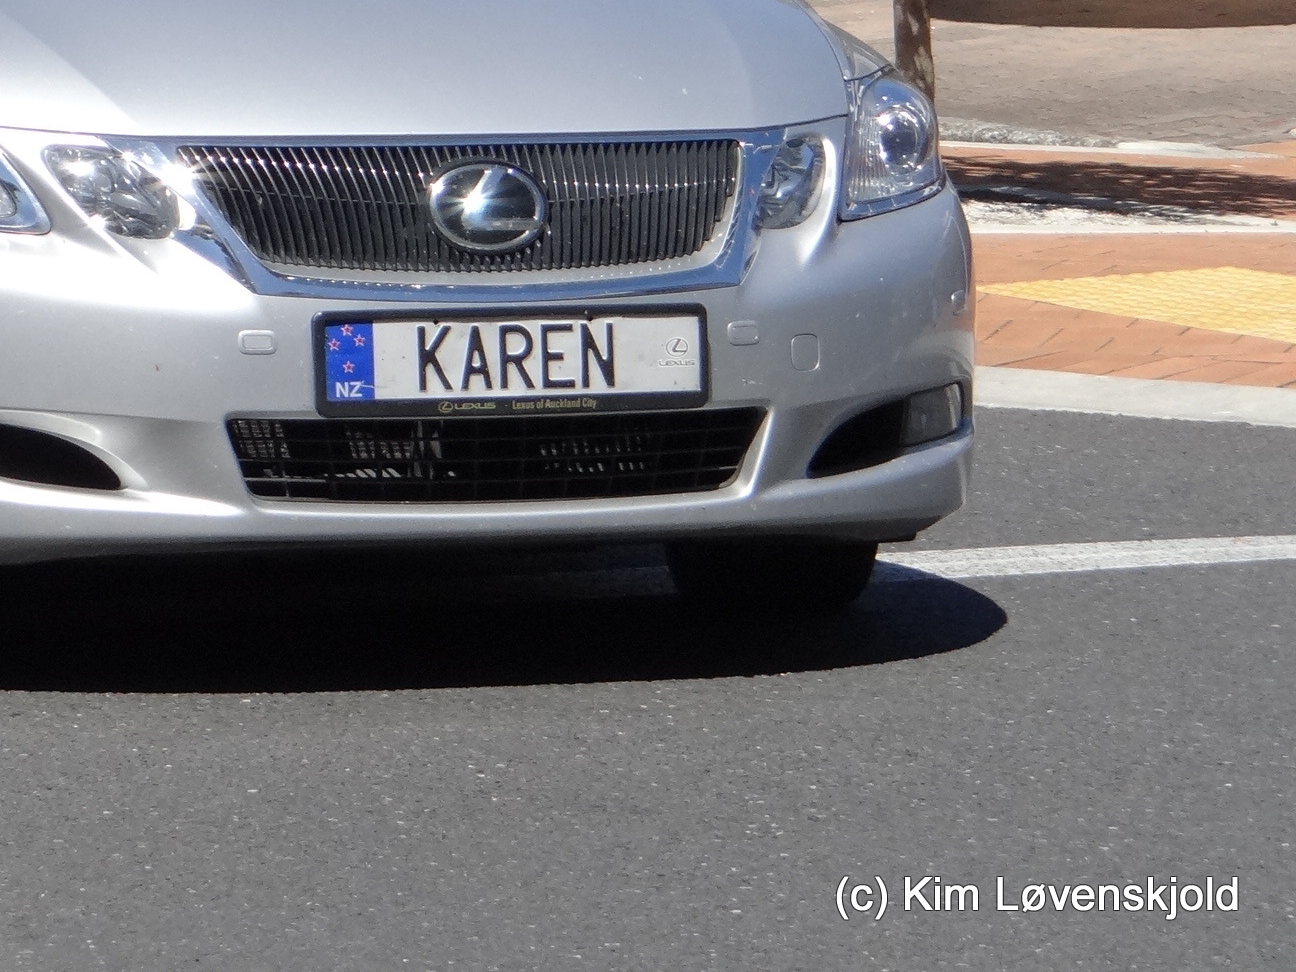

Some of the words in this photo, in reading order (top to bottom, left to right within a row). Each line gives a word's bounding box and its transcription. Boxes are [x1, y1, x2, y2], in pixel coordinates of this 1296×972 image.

[416, 322, 616, 392] KAREN
[658, 359, 696, 368] LEXUS
[335, 381, 363, 398] NZ
[455, 401, 496, 410] LEXUS
[512, 400, 535, 409] Lexus
[536, 399, 544, 409] of
[545, 398, 581, 409] Auckland
[582, 397, 597, 409] City
